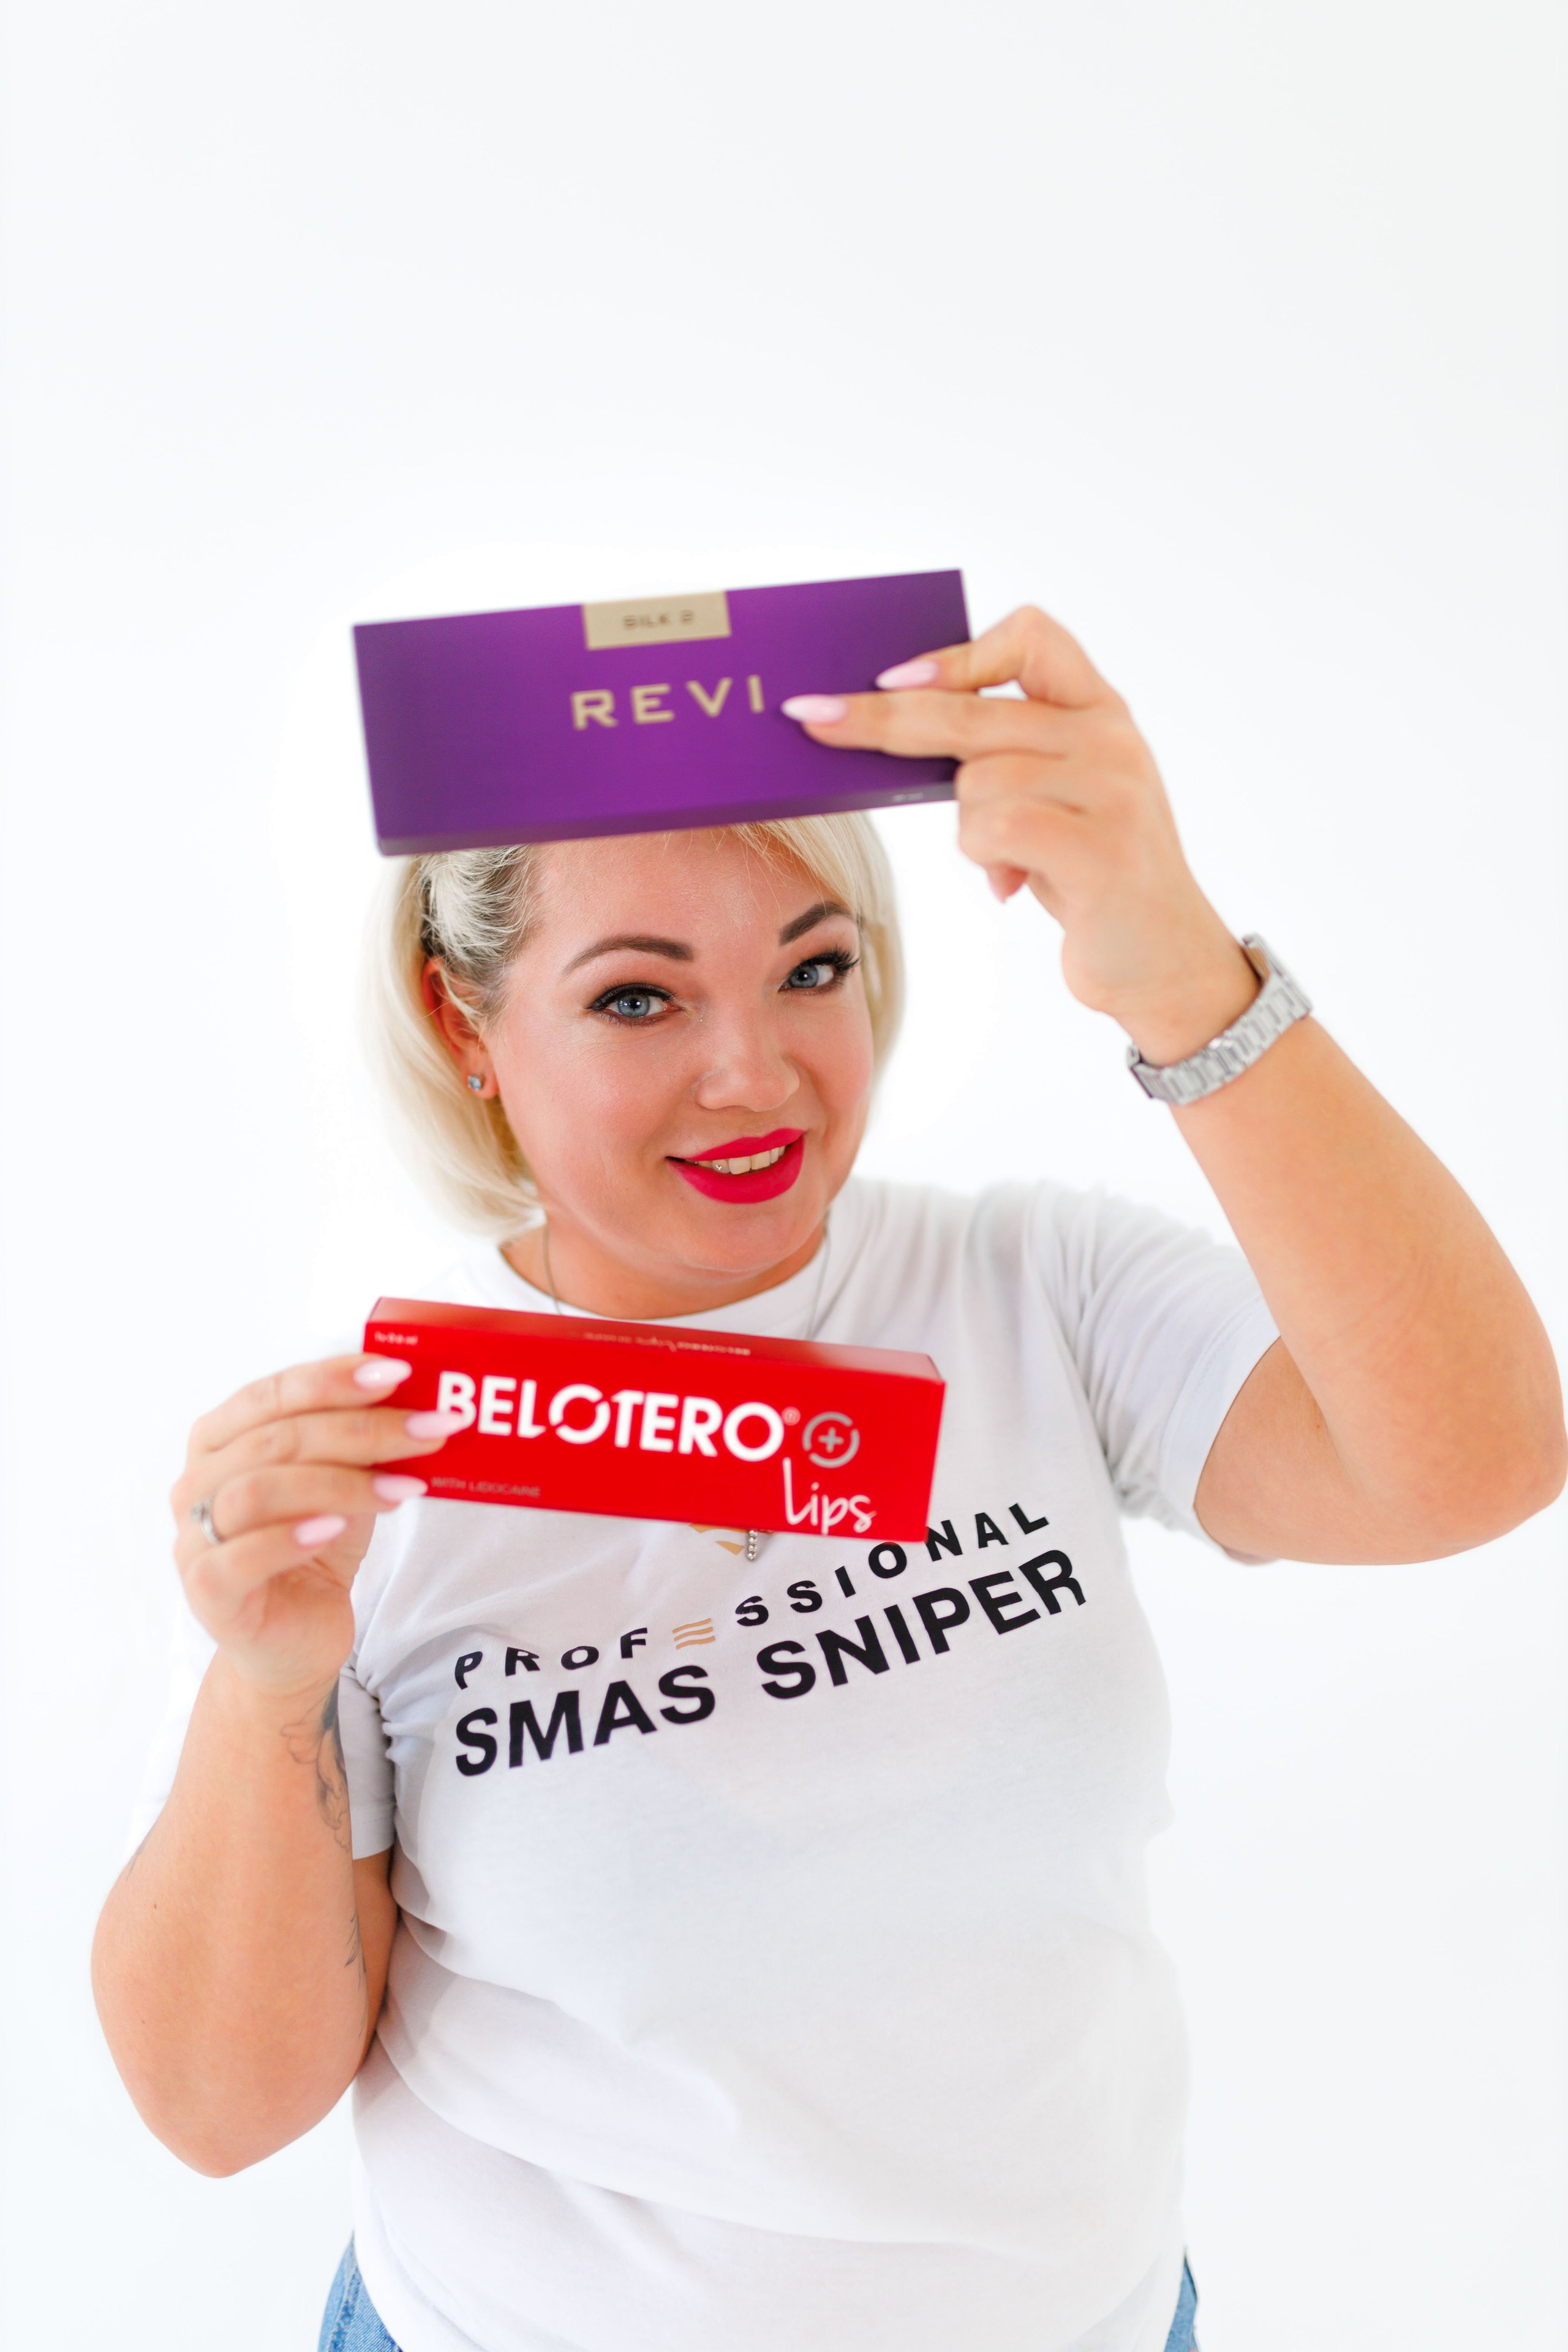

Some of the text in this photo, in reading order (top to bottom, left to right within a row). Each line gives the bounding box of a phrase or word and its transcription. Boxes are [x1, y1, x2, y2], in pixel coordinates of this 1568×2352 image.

[571, 674, 764, 730] REVI
[455, 1548, 1087, 1777] SMAS SNIPER
